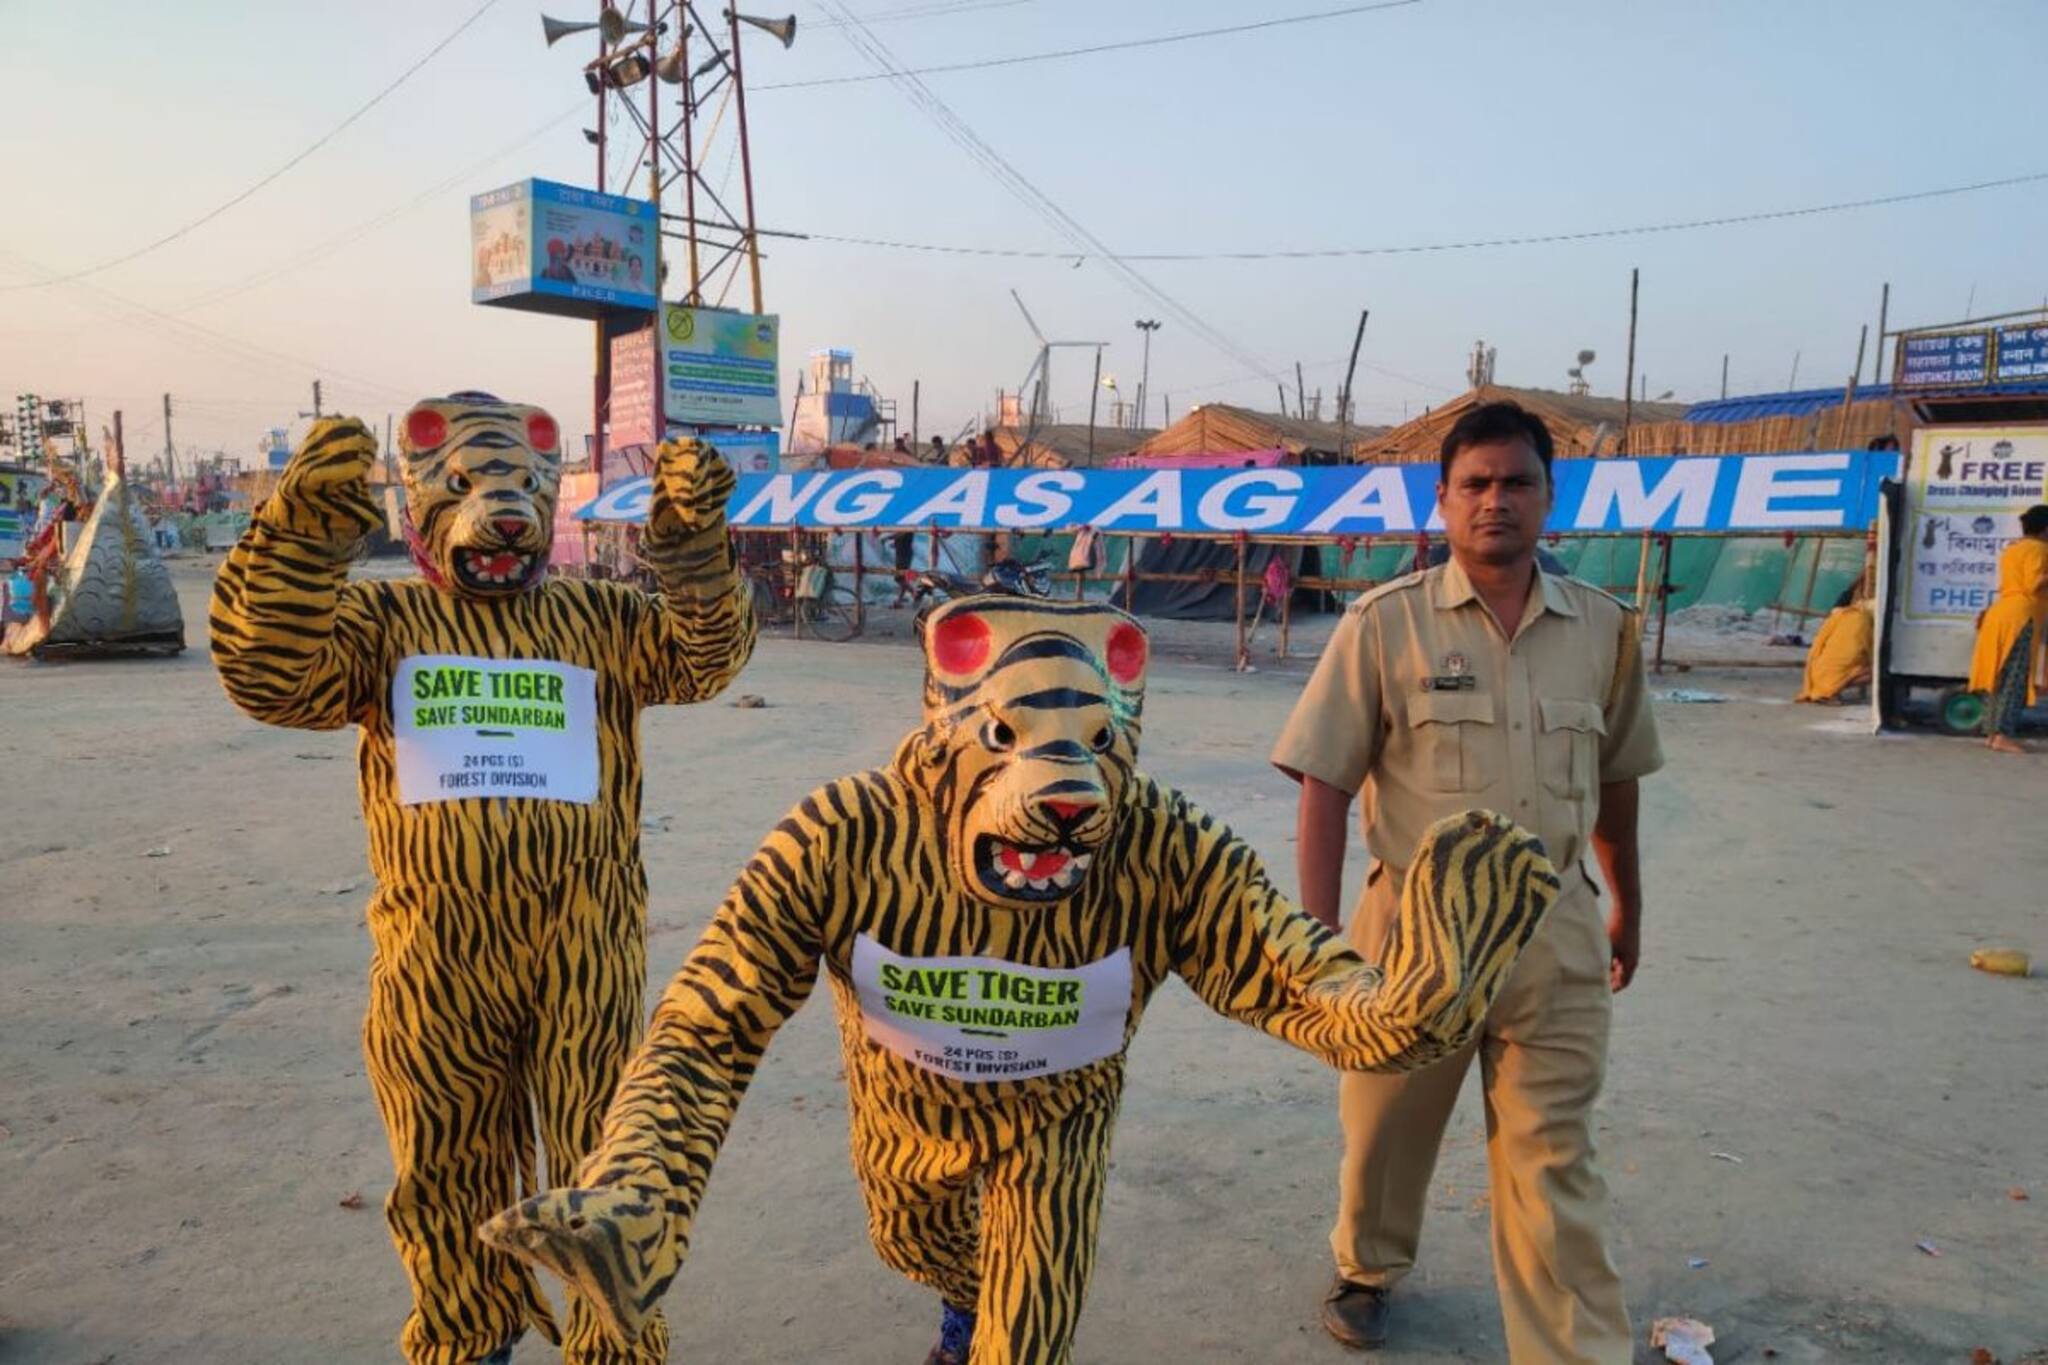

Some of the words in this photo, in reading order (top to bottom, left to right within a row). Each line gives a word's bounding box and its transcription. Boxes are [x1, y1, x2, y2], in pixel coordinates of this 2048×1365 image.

[1961, 462, 2045, 481] FREE
[592, 465, 1448, 533] GNGASAGA
[414, 669, 482, 700] SAVE
[488, 672, 564, 703] TIGER
[416, 706, 457, 727] SAVE
[462, 705, 566, 729] SUNDARBAN
[463, 755, 479, 767] 24
[440, 772, 487, 788] FOREST
[491, 772, 547, 787] DIVISION
[882, 964, 968, 999] SAVE
[977, 970, 1081, 1006] TIGER
[884, 995, 938, 1020] SAVE
[942, 1005, 1080, 1028] SUNDARBAN
[915, 1049, 972, 1073] FOREST
[976, 1059, 1047, 1075] DIVISION
[944, 1046, 963, 1058] 24
